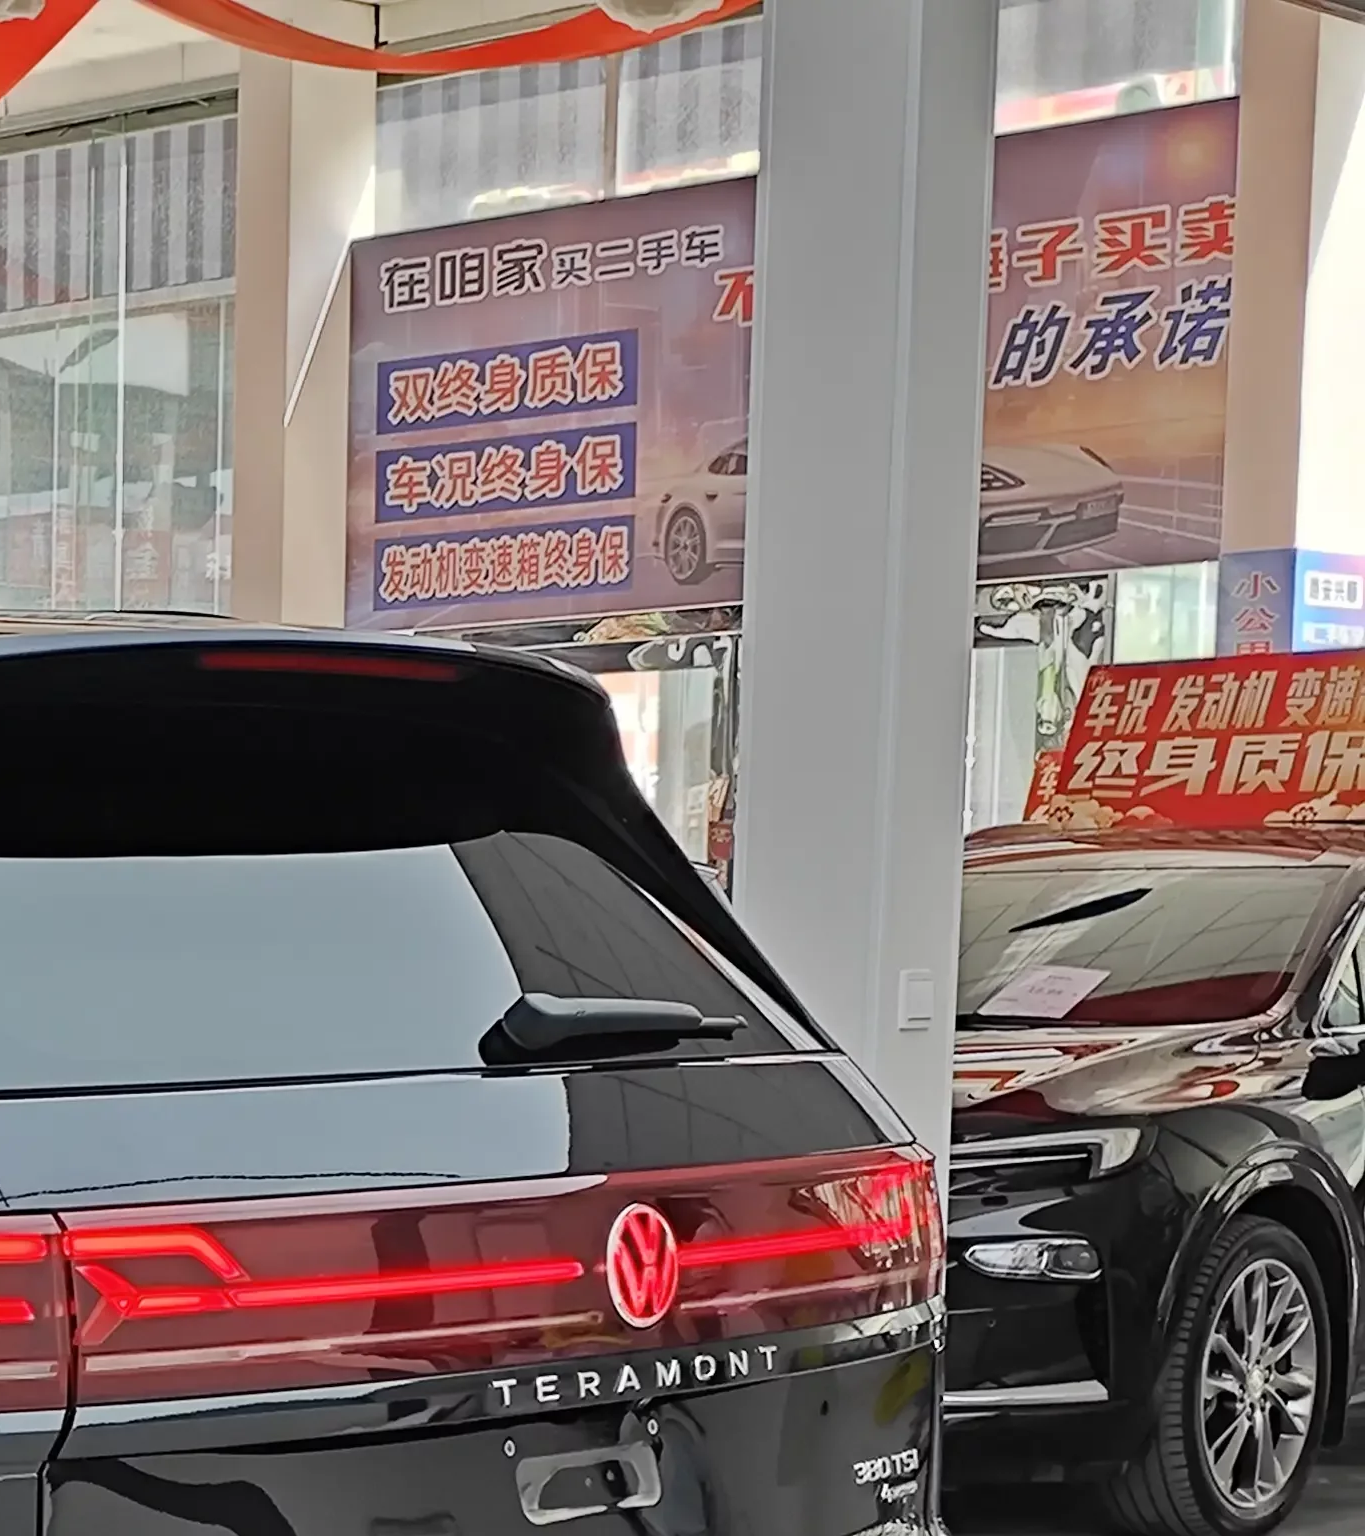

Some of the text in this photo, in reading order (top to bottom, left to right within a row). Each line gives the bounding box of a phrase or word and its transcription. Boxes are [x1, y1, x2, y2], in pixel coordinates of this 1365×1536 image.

[380, 224, 724, 314] 在咱家买二手车
[988, 275, 1232, 390] 的承诺
[388, 341, 624, 425] 双终身质保
[385, 433, 624, 513] 车况终身保
[379, 525, 630, 606] 发动机变速箱终身保
[1084, 665, 1365, 736] 车况 发动机 变速
[491, 1344, 782, 1405] TERAMONT
